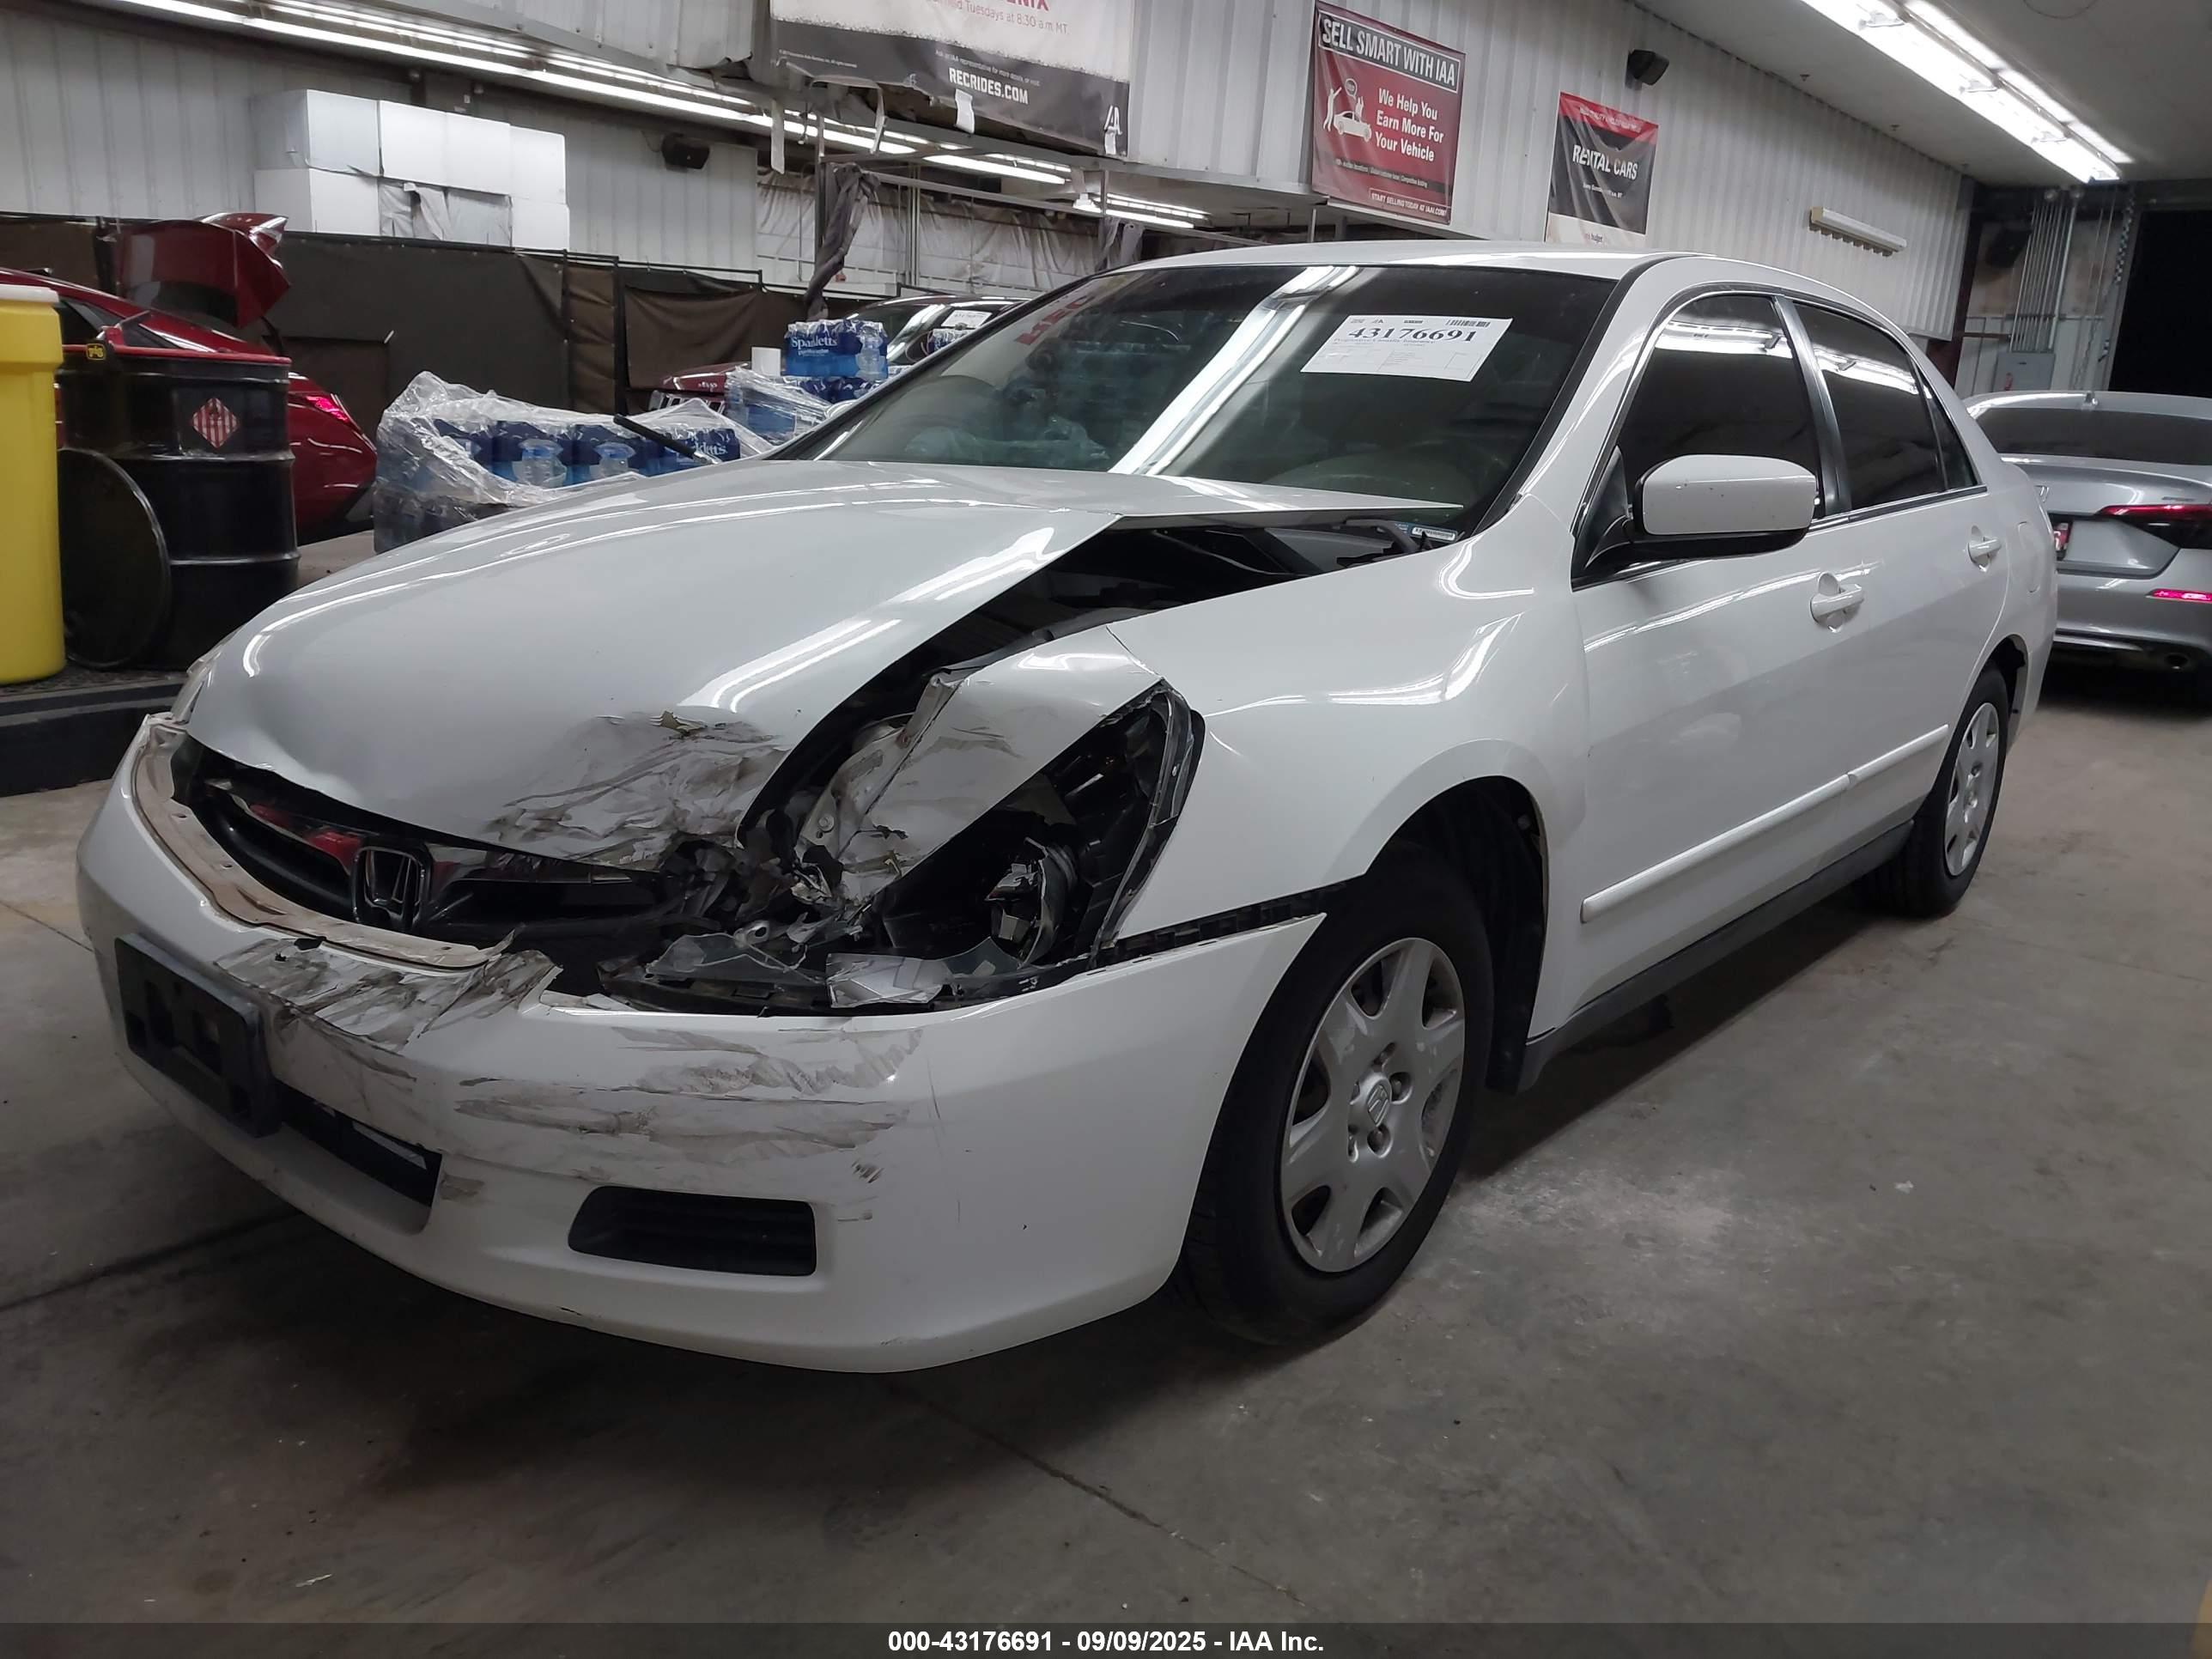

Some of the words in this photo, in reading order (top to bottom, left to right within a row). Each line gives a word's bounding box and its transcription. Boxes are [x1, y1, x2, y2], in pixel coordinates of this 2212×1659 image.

[1322, 18, 1353, 52] SELL
[1356, 30, 1401, 66] SMART
[1403, 46, 1434, 79] WITH
[1435, 58, 1455, 87] IAA
[948, 67, 1029, 105] RECRIDES.COM
[1378, 88, 1395, 107] We
[1396, 93, 1419, 117] Help
[1420, 100, 1438, 120] You
[1376, 109, 1399, 131] Earn
[1401, 117, 1426, 138] More
[1428, 125, 1444, 143] For
[1375, 131, 1398, 152] Your
[1400, 137, 1435, 161] Vehicle
[1572, 144, 1611, 173] RENTAL
[1613, 158, 1638, 180] CARS
[1348, 327, 1477, 342] 43176691
